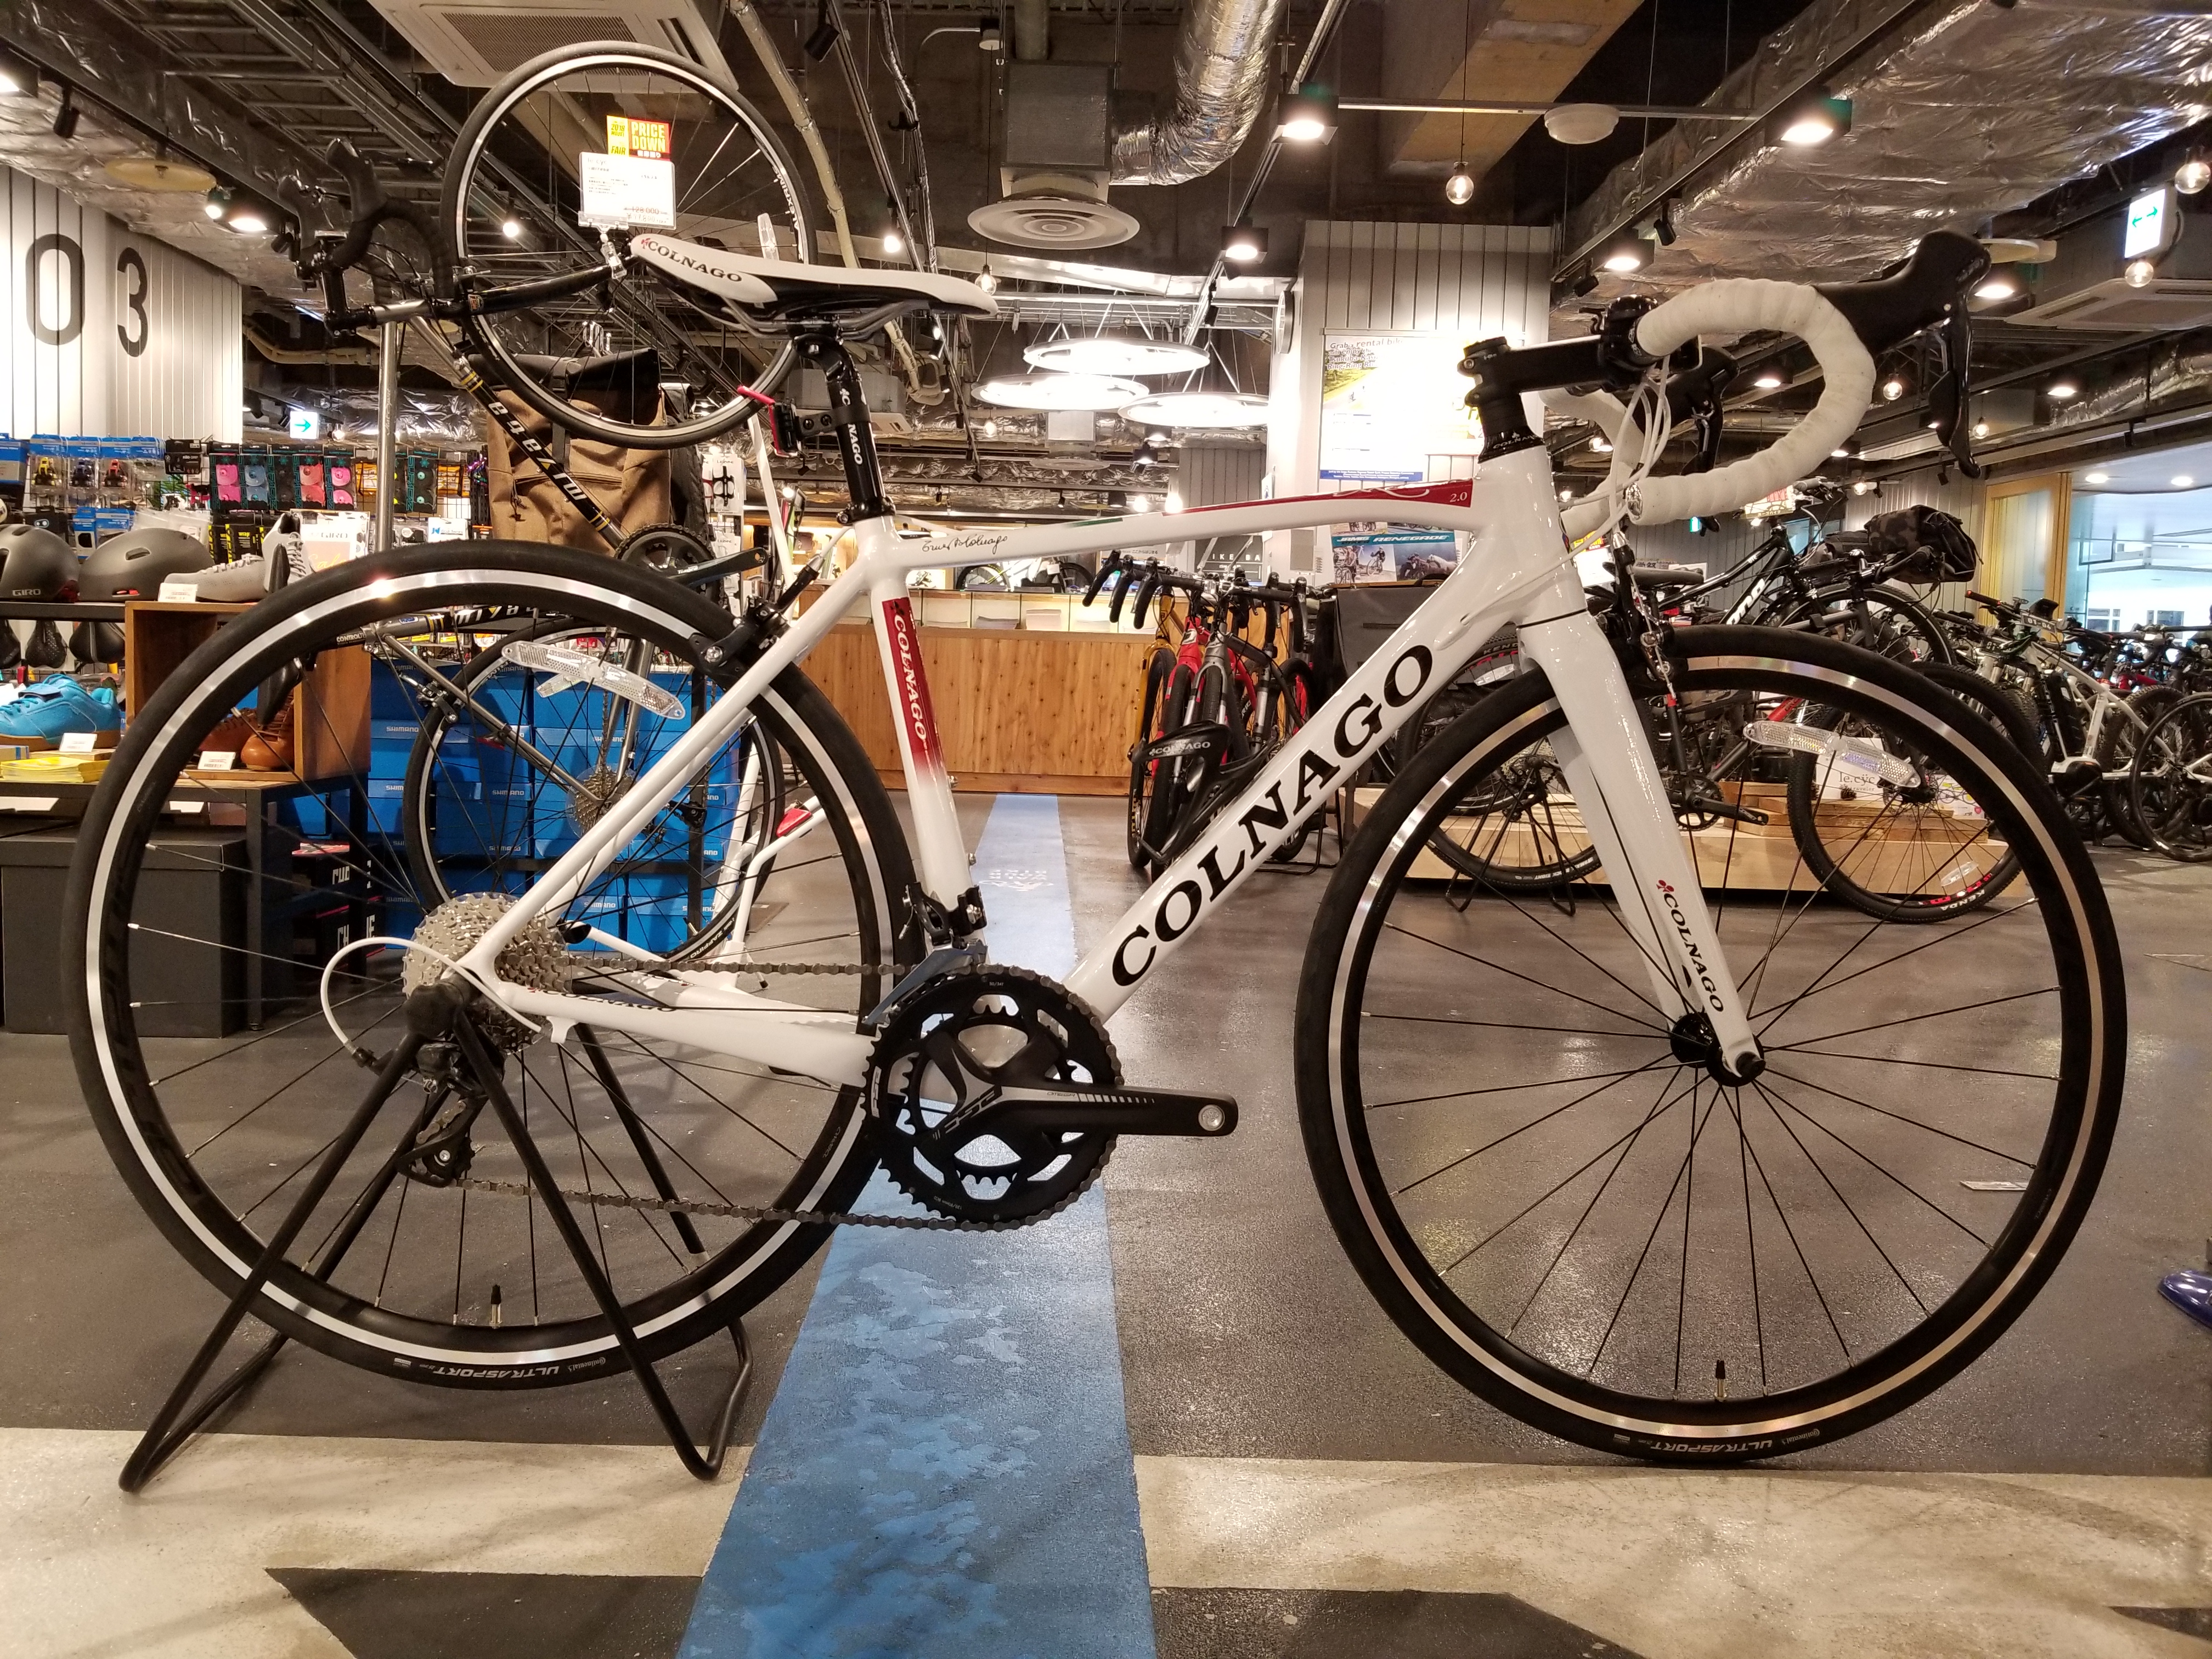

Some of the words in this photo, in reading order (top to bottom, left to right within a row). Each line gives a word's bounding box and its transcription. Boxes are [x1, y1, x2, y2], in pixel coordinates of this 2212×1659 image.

[631, 121, 665, 138] PRICE
[611, 146, 626, 155] FAIR
[631, 135, 665, 152] DOWN
[648, 240, 742, 282] COLNAGO
[1356, 338, 1384, 348] rental
[842, 395, 863, 465] CNAGO
[1449, 492, 1468, 503] 2.0
[2027, 618, 2052, 630] 01-04
[894, 614, 927, 741] COLNAGO
[1111, 645, 1433, 987] COLNAGO
[1940, 889, 1985, 911] KENDA
[1663, 893, 1724, 1012] COLNAGO
[433, 1365, 560, 1379] ULTRASPORT
[573, 1356, 606, 1372] Continental
[1785, 1428, 1821, 1444] Continental
[1650, 1439, 1773, 1453] ULTRASPORT
